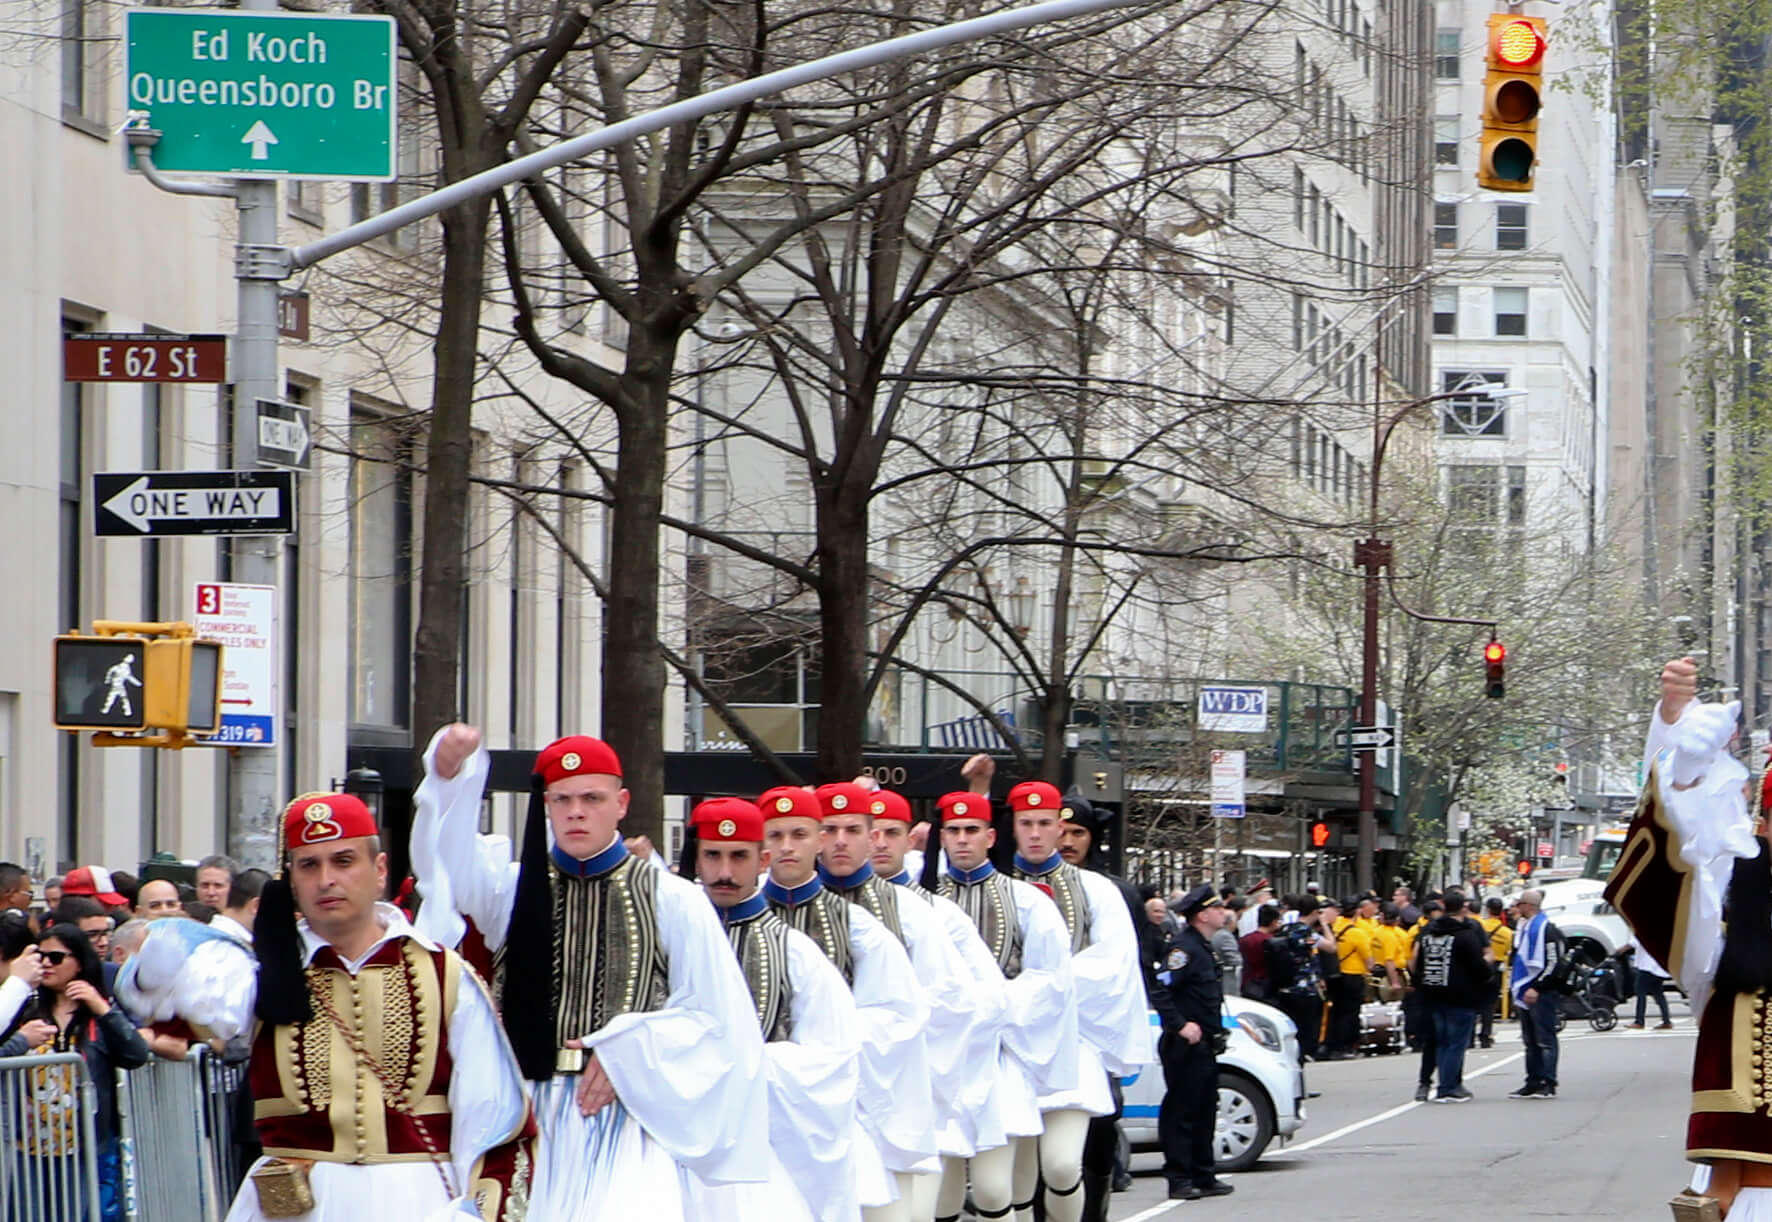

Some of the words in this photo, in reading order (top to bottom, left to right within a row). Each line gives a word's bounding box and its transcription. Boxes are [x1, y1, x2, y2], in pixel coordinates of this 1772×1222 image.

[191, 29, 229, 61] Ed
[246, 31, 328, 64] Koch
[130, 72, 336, 109] Queensboro
[353, 79, 388, 110] Br
[97, 346, 112, 377] E
[125, 346, 158, 378] 62
[168, 346, 198, 378] St
[130, 492, 190, 517] ONE
[205, 491, 266, 516] WAY
[201, 587, 217, 614] 3
[200, 621, 258, 635] COMMERCIAL
[245, 636, 267, 649] ONLY
[1203, 689, 1262, 713] WDP
